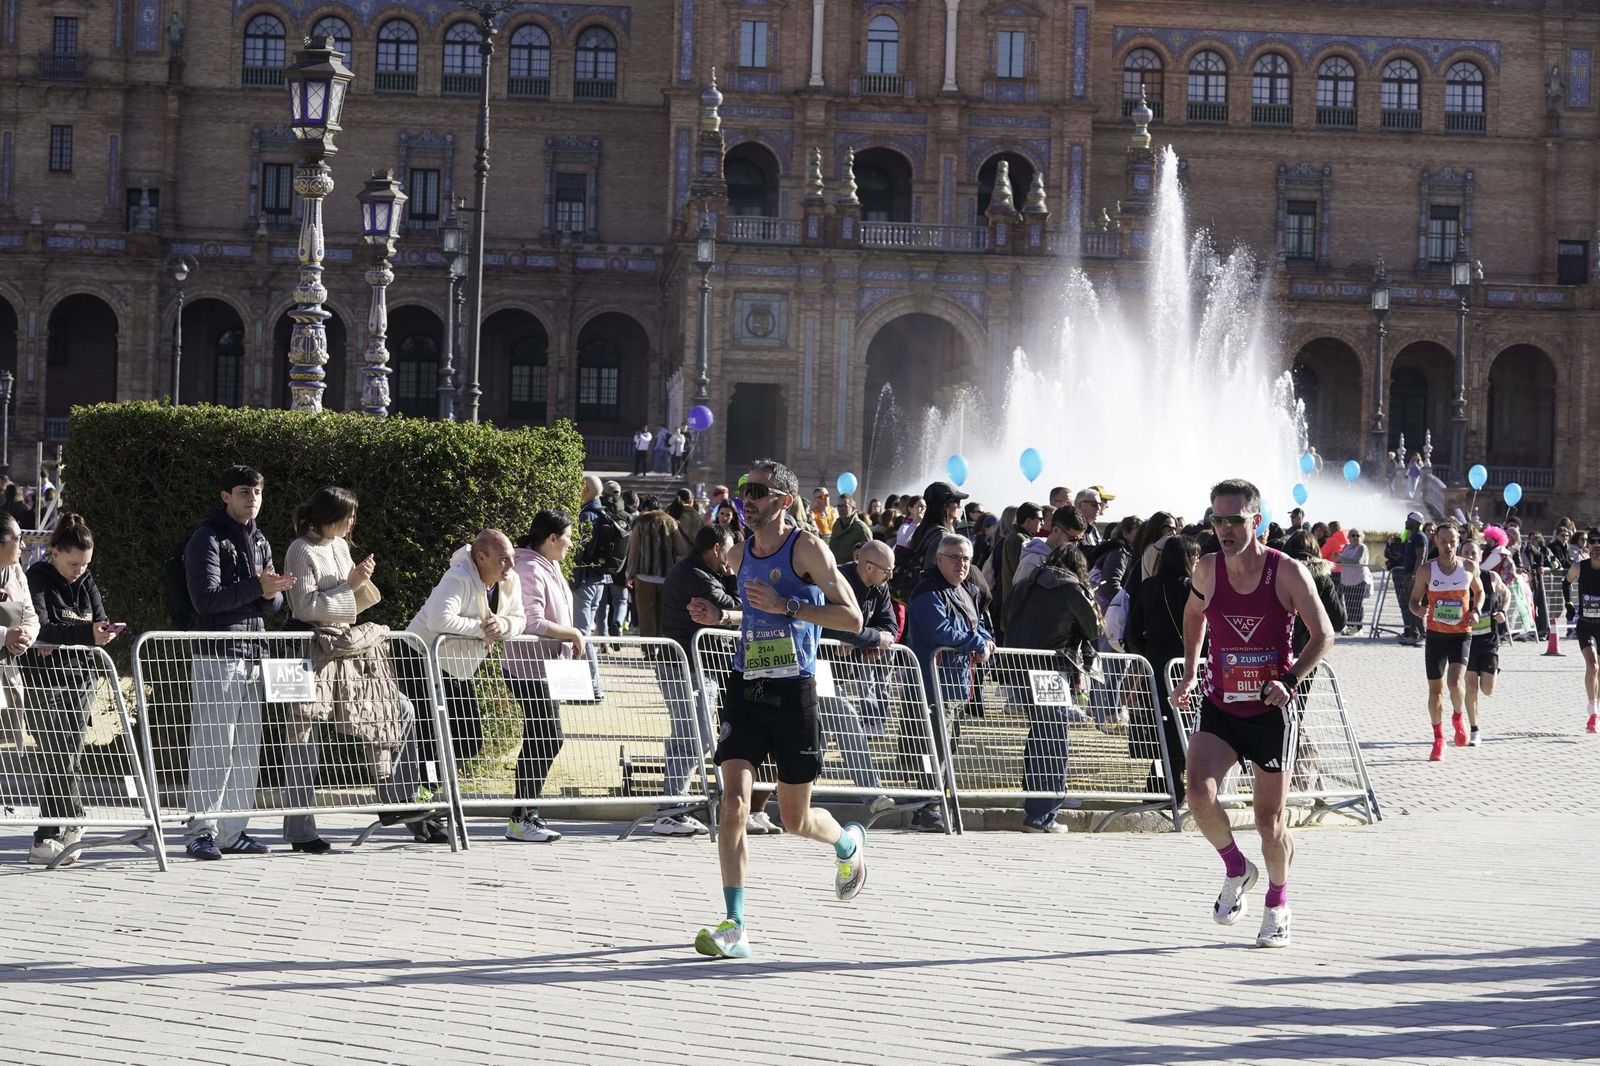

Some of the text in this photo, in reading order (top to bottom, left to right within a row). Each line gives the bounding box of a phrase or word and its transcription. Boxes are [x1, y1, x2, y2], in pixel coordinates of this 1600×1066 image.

[758, 645, 775, 654] 2144
[773, 652, 798, 666] RUIZ
[276, 664, 304, 683] AMS
[1038, 675, 1060, 691] AMS
[1237, 680, 1265, 691] BILLY
